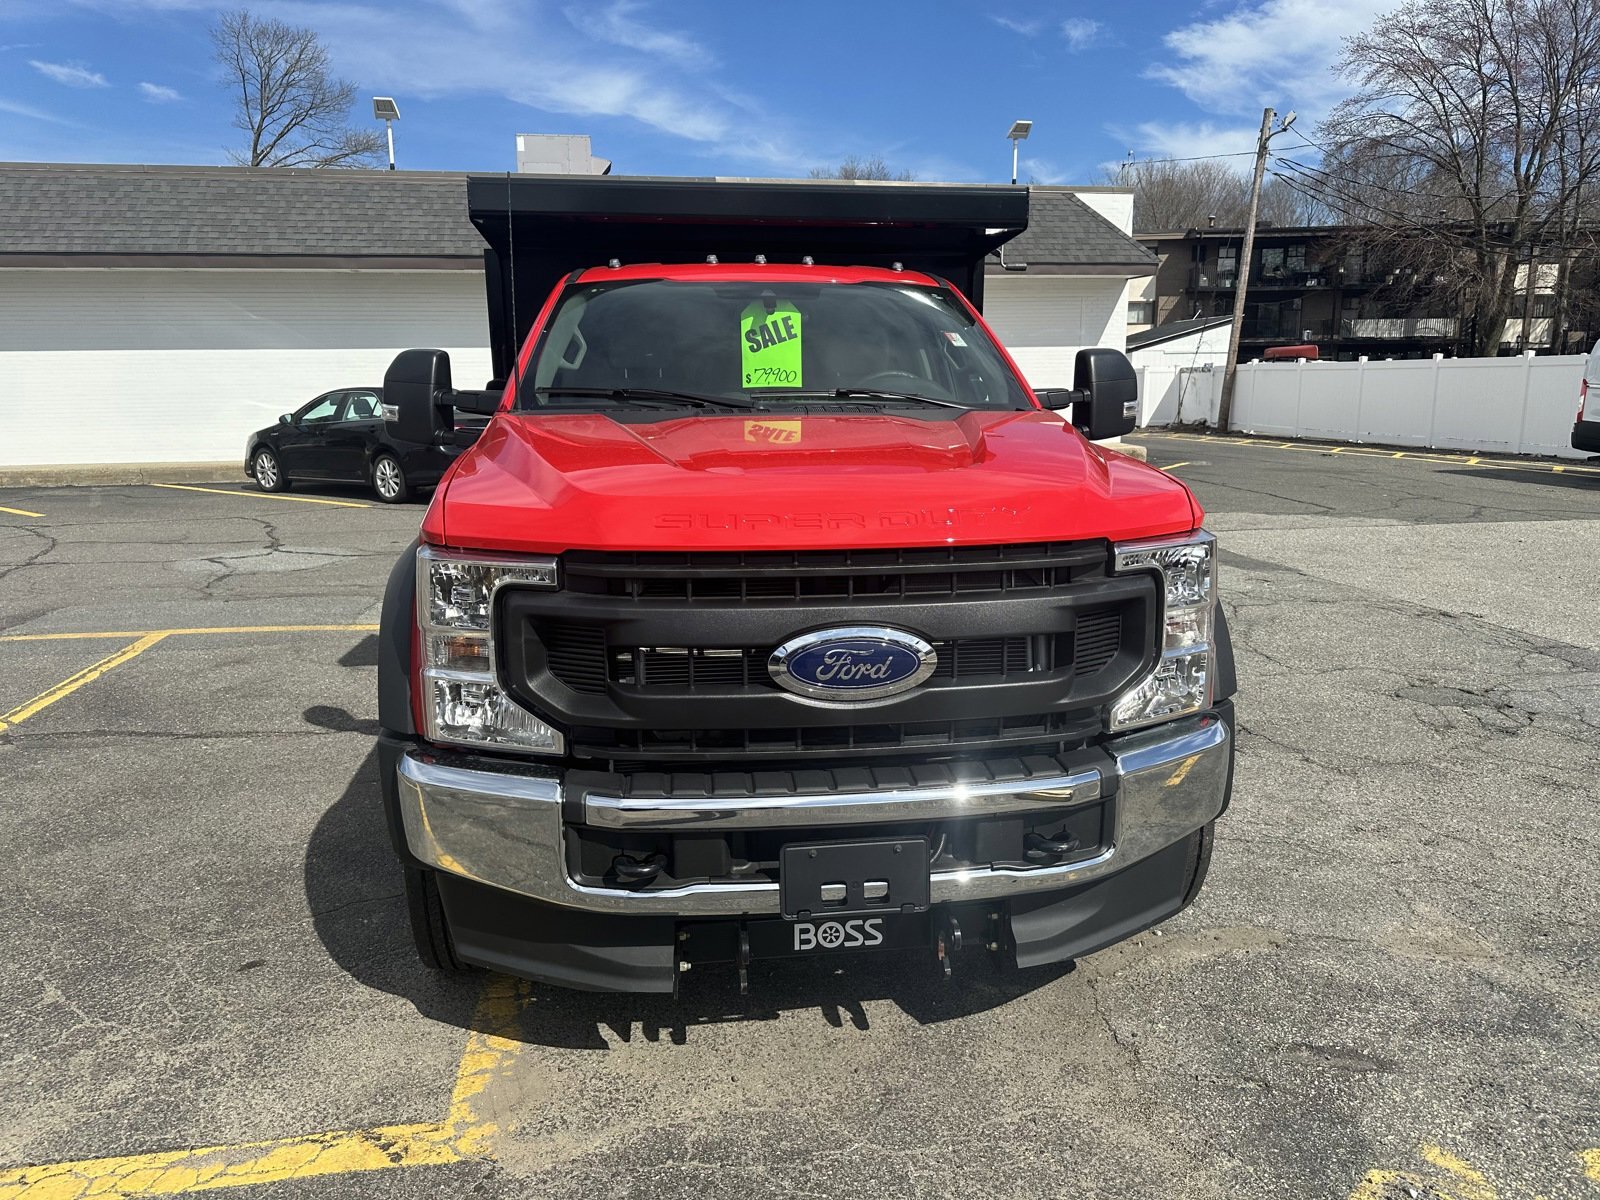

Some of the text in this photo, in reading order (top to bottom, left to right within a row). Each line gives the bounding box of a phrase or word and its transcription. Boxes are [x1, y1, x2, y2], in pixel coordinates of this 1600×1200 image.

[744, 315, 798, 353] SALE
[653, 512, 866, 531] SUPER
[815, 648, 894, 681] Ford
[794, 918, 884, 951] BOSS
